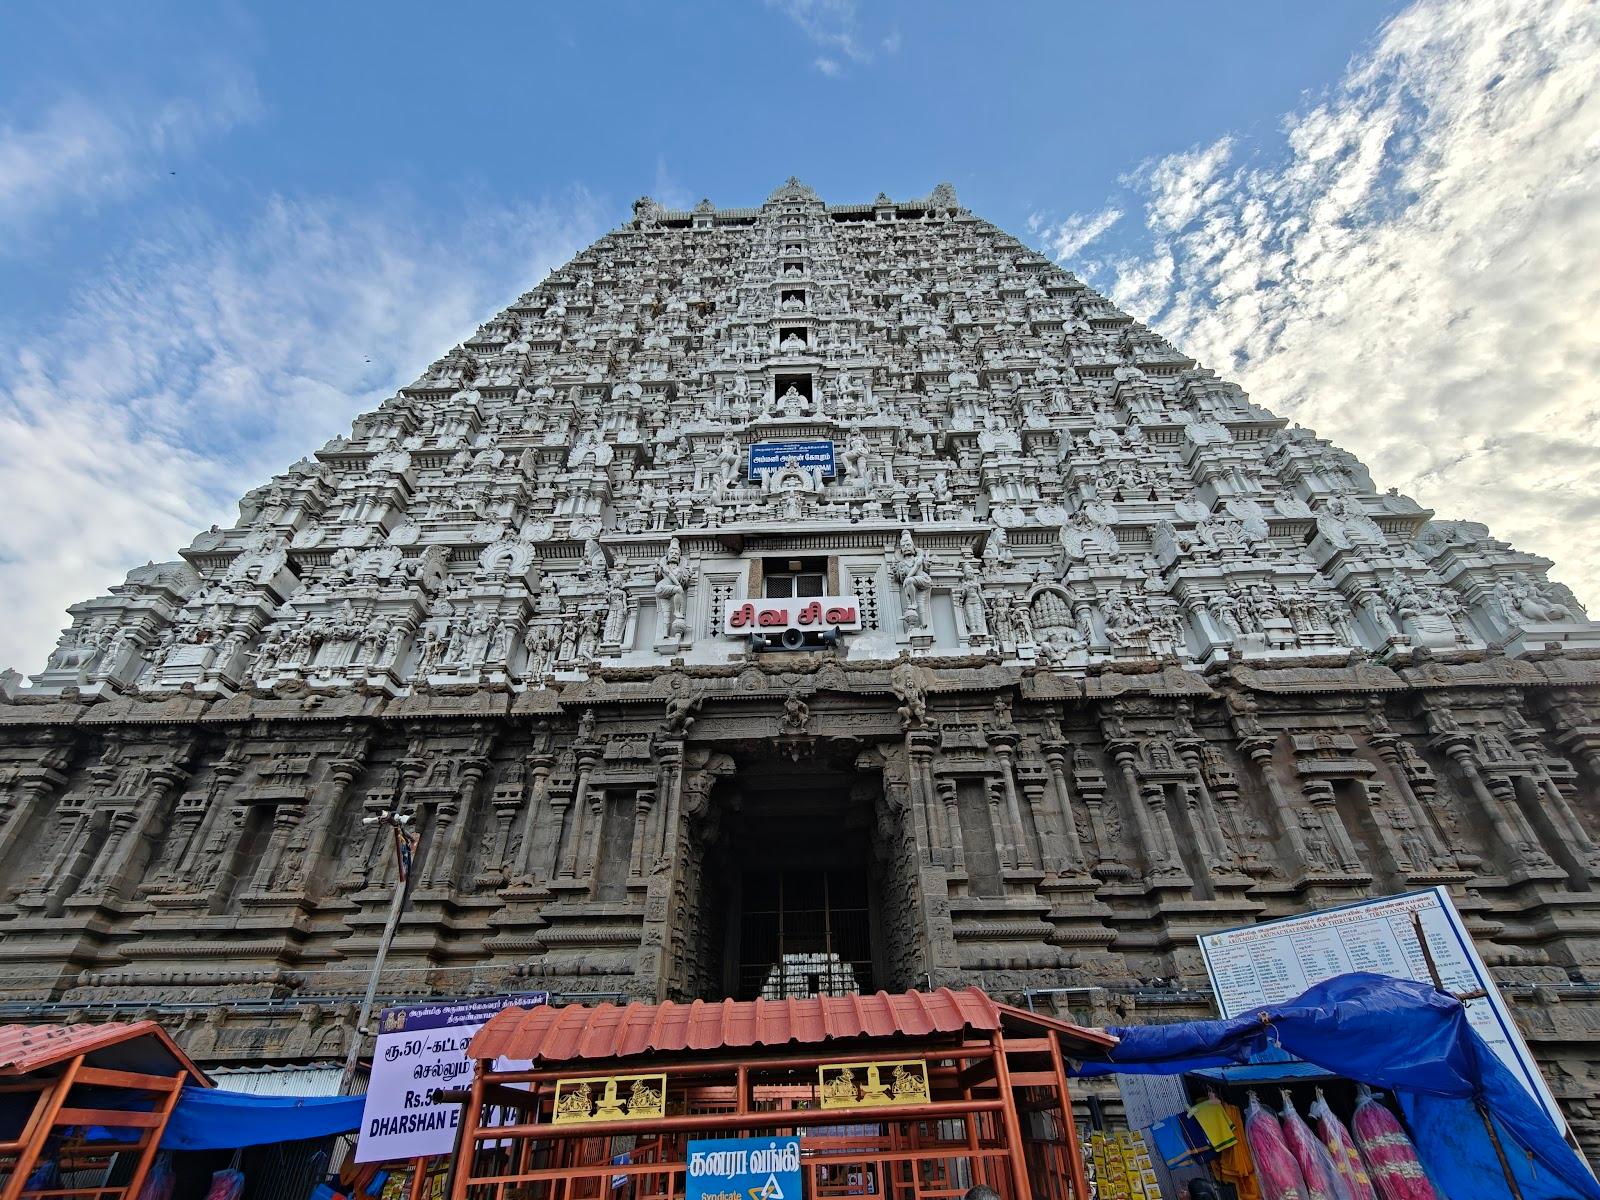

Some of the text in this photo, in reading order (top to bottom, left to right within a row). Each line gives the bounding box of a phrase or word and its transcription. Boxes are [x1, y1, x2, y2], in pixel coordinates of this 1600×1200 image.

[730, 601, 856, 628] சிவ சிவ
[1228, 934, 1258, 945] ARULMIGU
[409, 1007, 441, 1018] அருள்மிகு
[413, 1056, 470, 1081] செல்லும்
[369, 1110, 446, 1138] DHARSHAN
[689, 1142, 800, 1179] கனரா வங்கி
